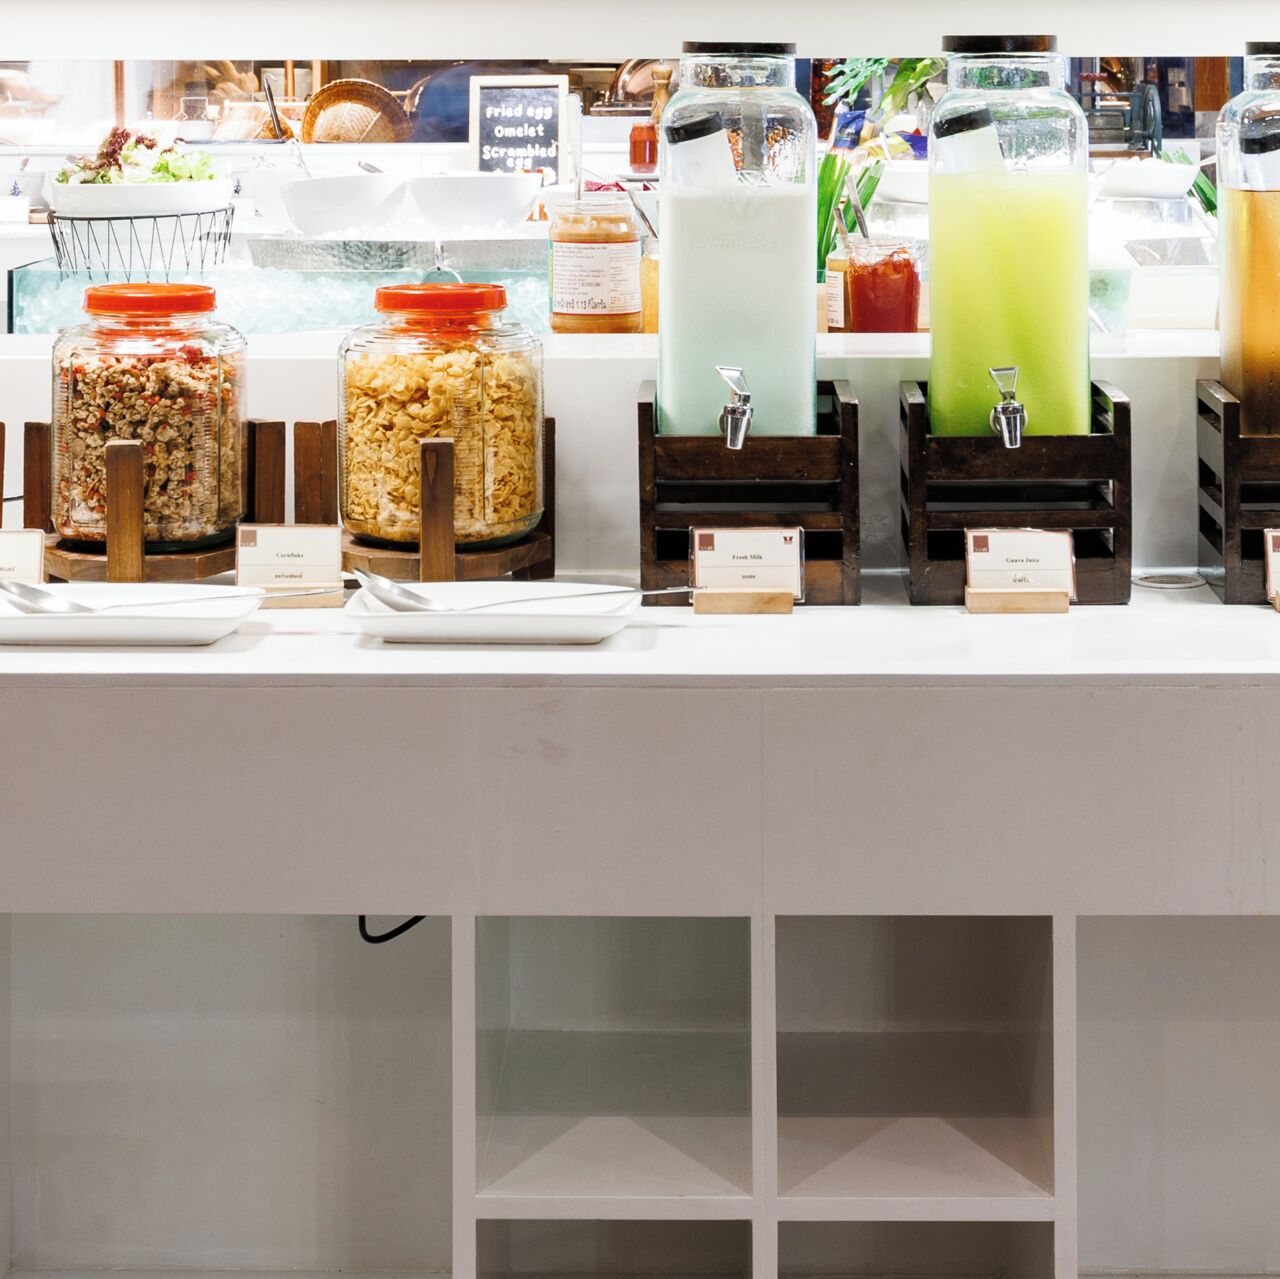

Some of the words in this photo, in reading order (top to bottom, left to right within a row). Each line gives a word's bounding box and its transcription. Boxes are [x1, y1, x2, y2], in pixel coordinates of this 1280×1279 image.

[485, 104, 523, 119] Fried
[526, 106, 553, 120] egg
[494, 122, 545, 137] Omelet
[482, 143, 557, 160] Scrambled
[506, 157, 533, 170] egg
